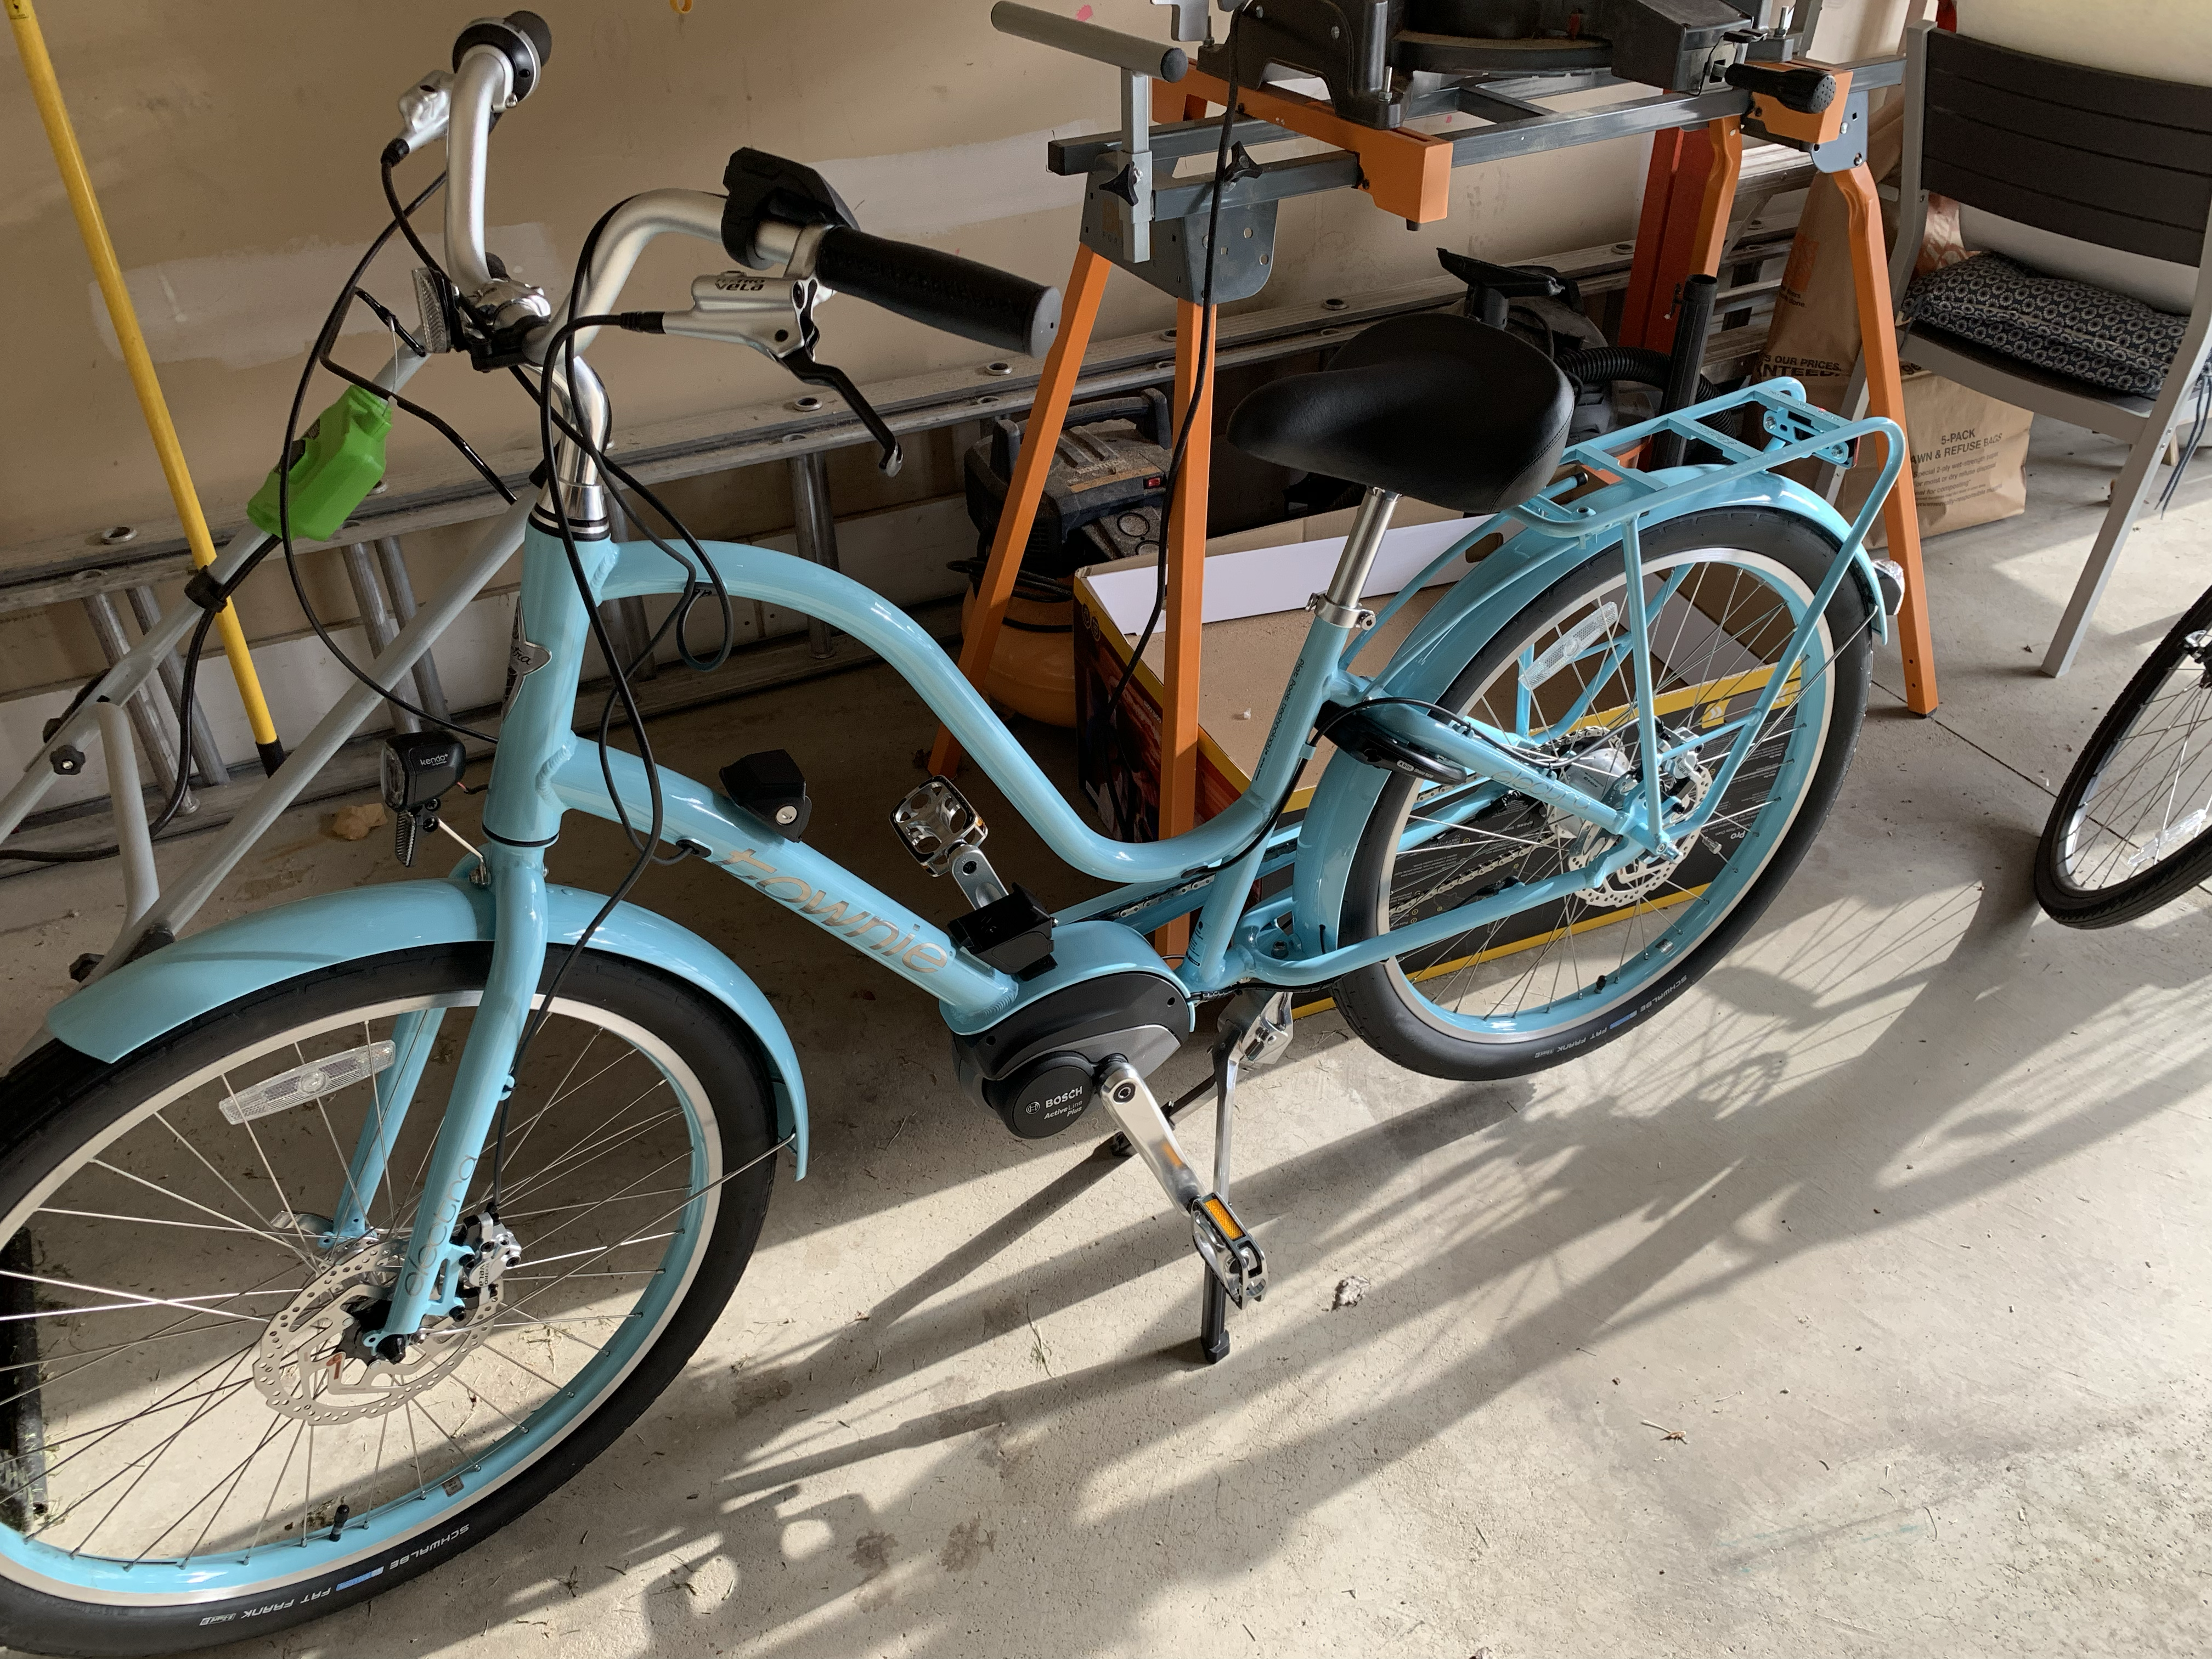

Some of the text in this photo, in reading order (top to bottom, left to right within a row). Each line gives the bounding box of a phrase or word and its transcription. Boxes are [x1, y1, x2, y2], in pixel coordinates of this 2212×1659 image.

[1762, 364, 1840, 377] NTEED.
[1775, 356, 1797, 365] OUR
[1941, 428, 1976, 445] 5-PACK
[1910, 433, 2002, 465] AWN & REFUSE BAGS
[1730, 830, 1746, 839] Pro
[713, 848, 947, 973] townie
[1640, 974, 1687, 1012] SCHWALBE
[1557, 1027, 1607, 1053] FAT FRANK
[1046, 1086, 1082, 1108] BOSCH
[1066, 1107, 1082, 1117] Plus
[405, 1154, 478, 1296] electra
[390, 1523, 470, 1570] SCHWALBE
[300, 1587, 332, 1605] FAT
[240, 1599, 295, 1619] FRANK
